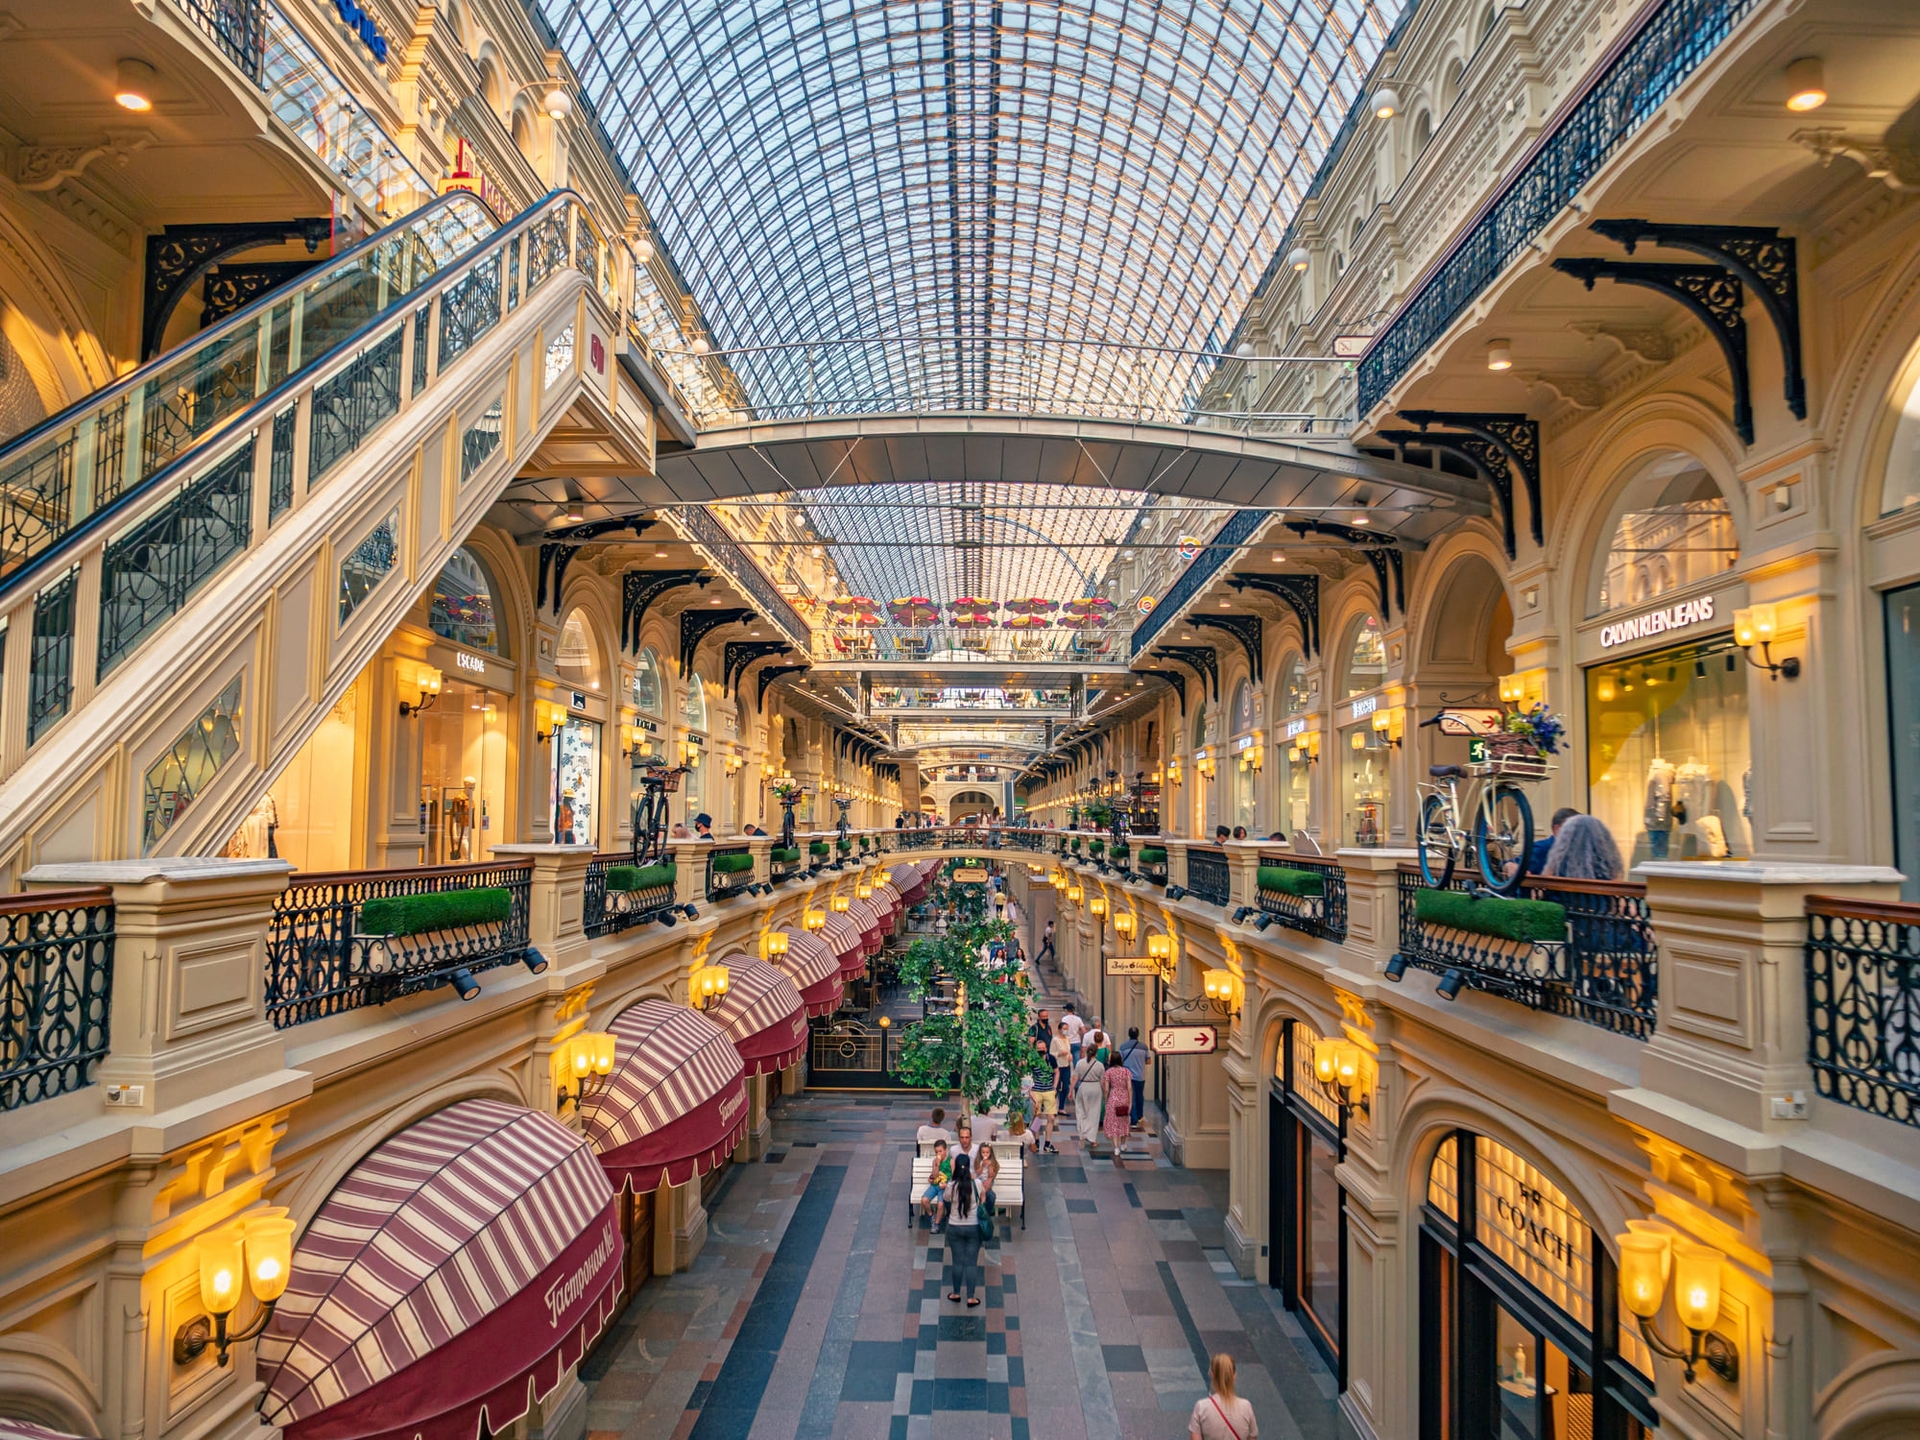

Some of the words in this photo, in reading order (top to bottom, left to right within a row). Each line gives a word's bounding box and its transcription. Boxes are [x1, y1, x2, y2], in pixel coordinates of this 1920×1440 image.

[1600, 617, 1639, 648] CALVIN
[1639, 608, 1671, 637] KLEIN
[1670, 595, 1715, 629] JEANS
[1497, 1196, 1573, 1269] COACH
[543, 1239, 607, 1330] Гастроном
